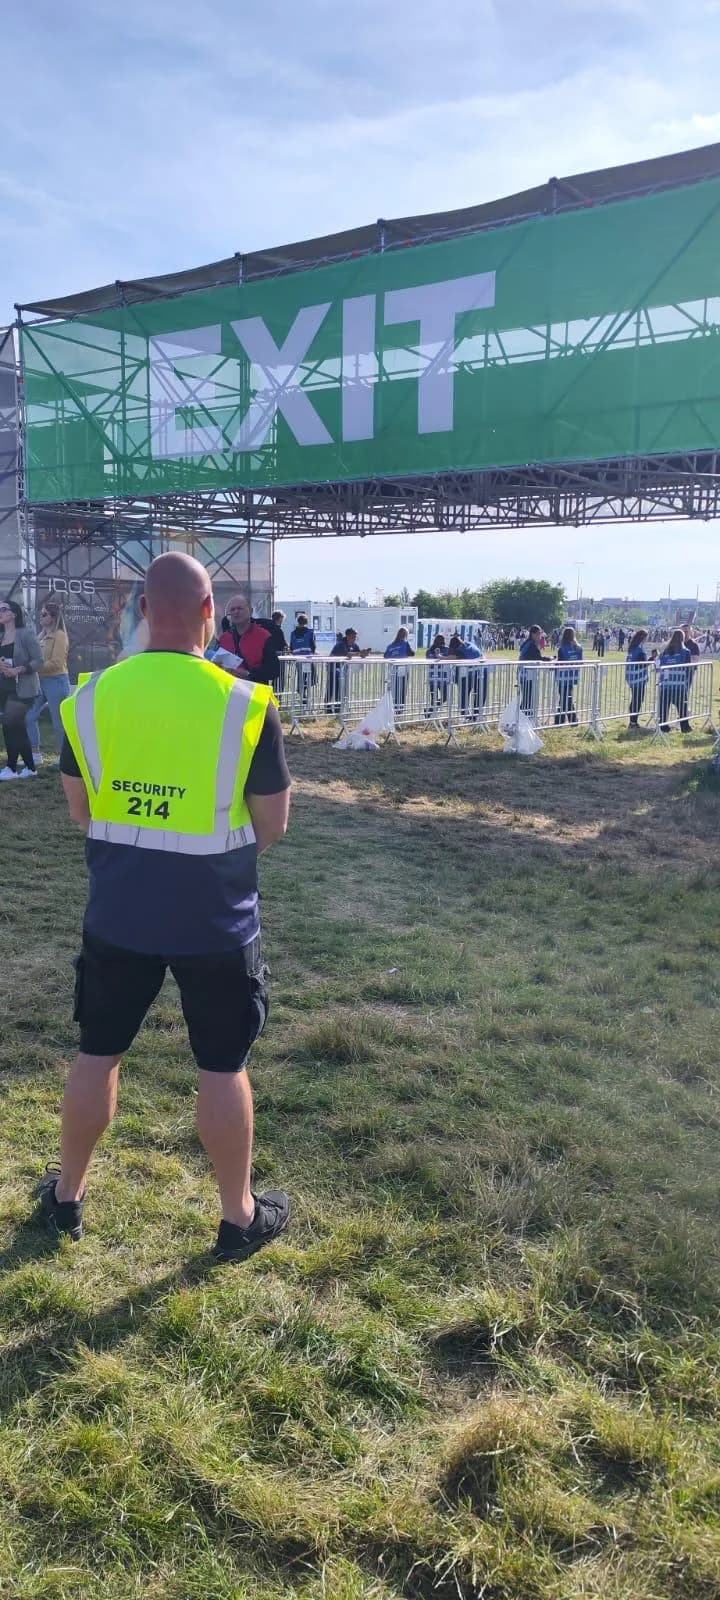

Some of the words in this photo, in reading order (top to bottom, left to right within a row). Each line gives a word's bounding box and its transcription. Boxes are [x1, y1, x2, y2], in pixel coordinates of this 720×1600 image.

[149, 270, 496, 459] EXIT
[48, 577, 96, 595] IQOS
[111, 779, 187, 800] SECURITY
[127, 796, 170, 820] 214
